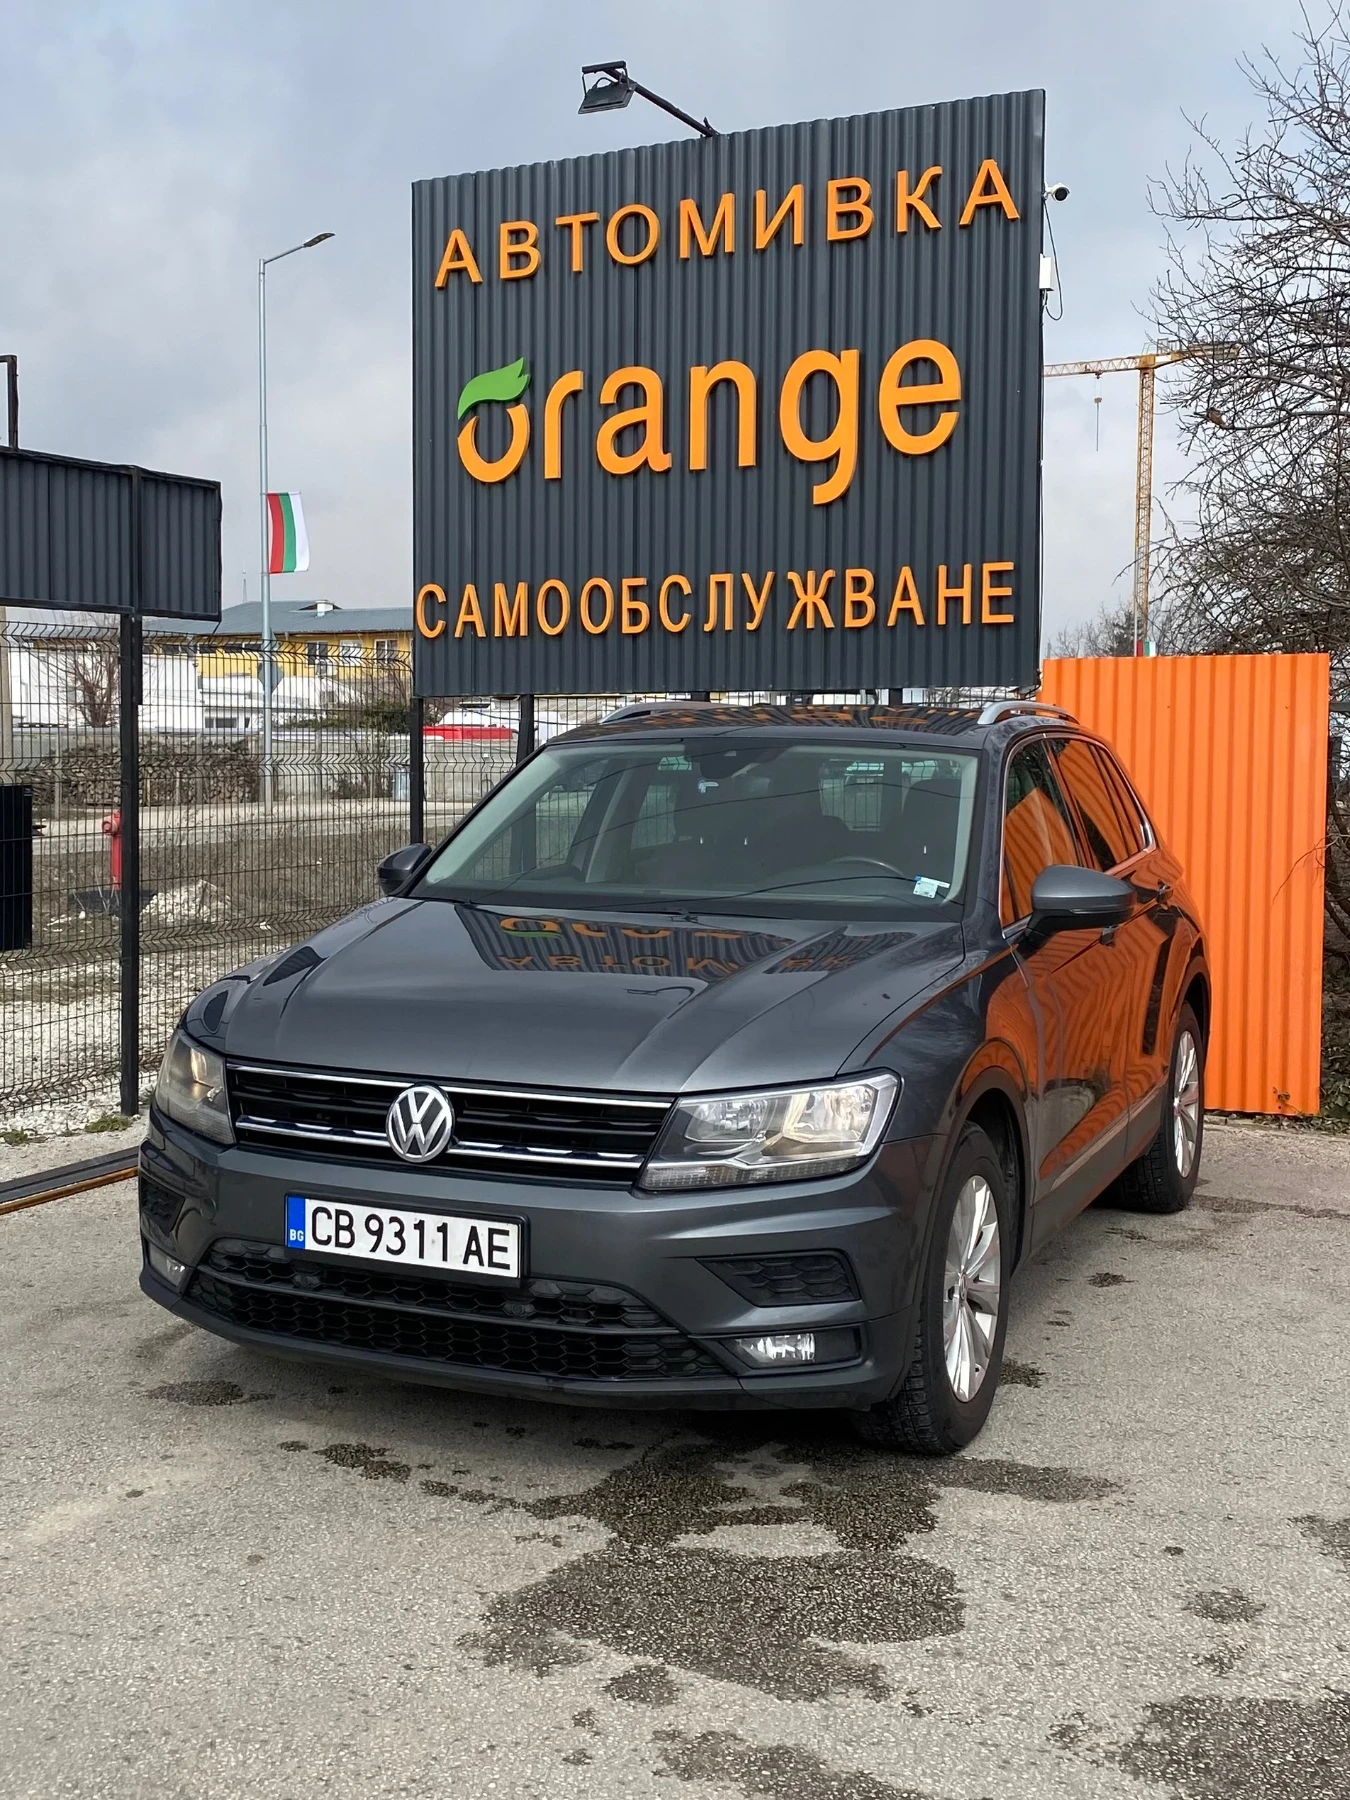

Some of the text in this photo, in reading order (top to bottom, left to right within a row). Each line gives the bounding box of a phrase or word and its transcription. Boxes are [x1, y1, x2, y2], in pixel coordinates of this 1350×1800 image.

[434, 158, 1020, 288] АВТОМИВКА
[457, 338, 962, 505] orange
[416, 561, 1015, 638] САМООБСЛУЖВАНЕ
[289, 1229, 305, 1242] BG
[364, 1213, 449, 1262] 9311
